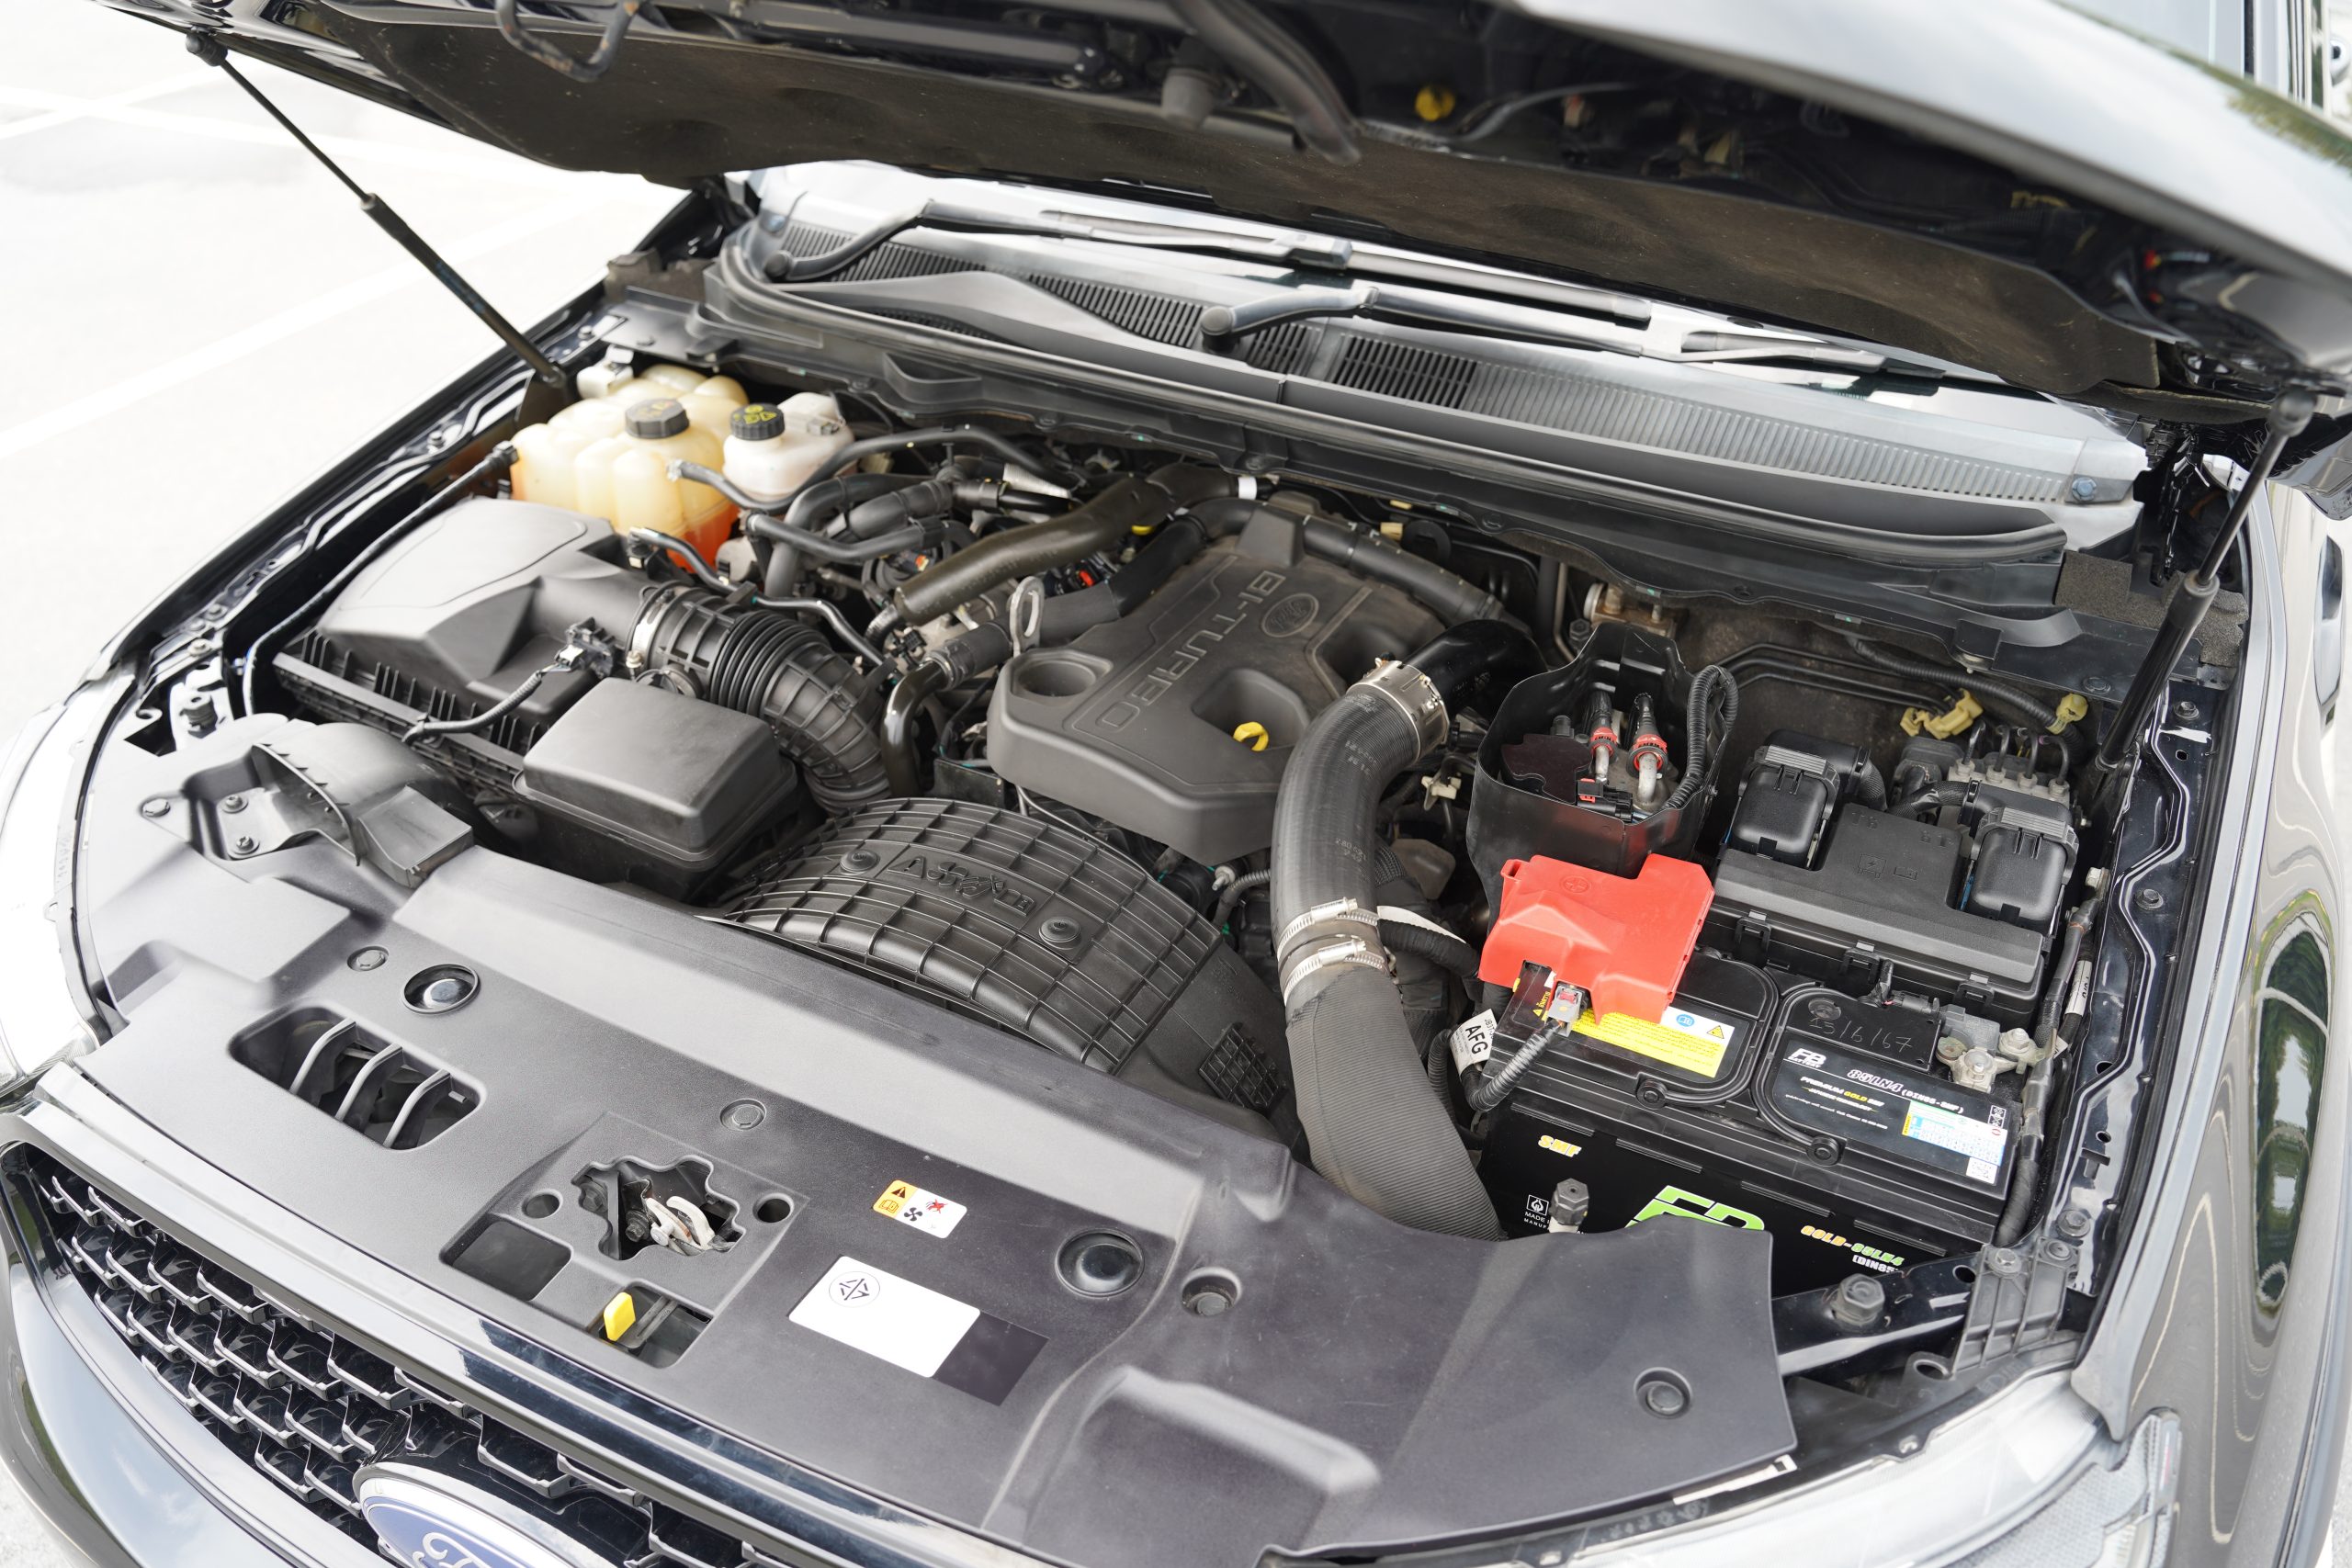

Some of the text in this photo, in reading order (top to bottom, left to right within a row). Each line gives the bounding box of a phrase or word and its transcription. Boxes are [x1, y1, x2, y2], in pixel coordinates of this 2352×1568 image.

[1095, 570, 1285, 732] BI-TURBO
[1465, 1025, 1488, 1055] AFG
[1791, 1048, 1827, 1066] FB
[1800, 1076, 1845, 1095] PREMIUM
[1843, 1090, 1868, 1102] GOLD
[1538, 1134, 1582, 1157] SMF
[1525, 1212, 1546, 1224] MADE
[1801, 1224, 1905, 1267] GOLD-85LN4
[1852, 1254, 1899, 1273] (DIN85
